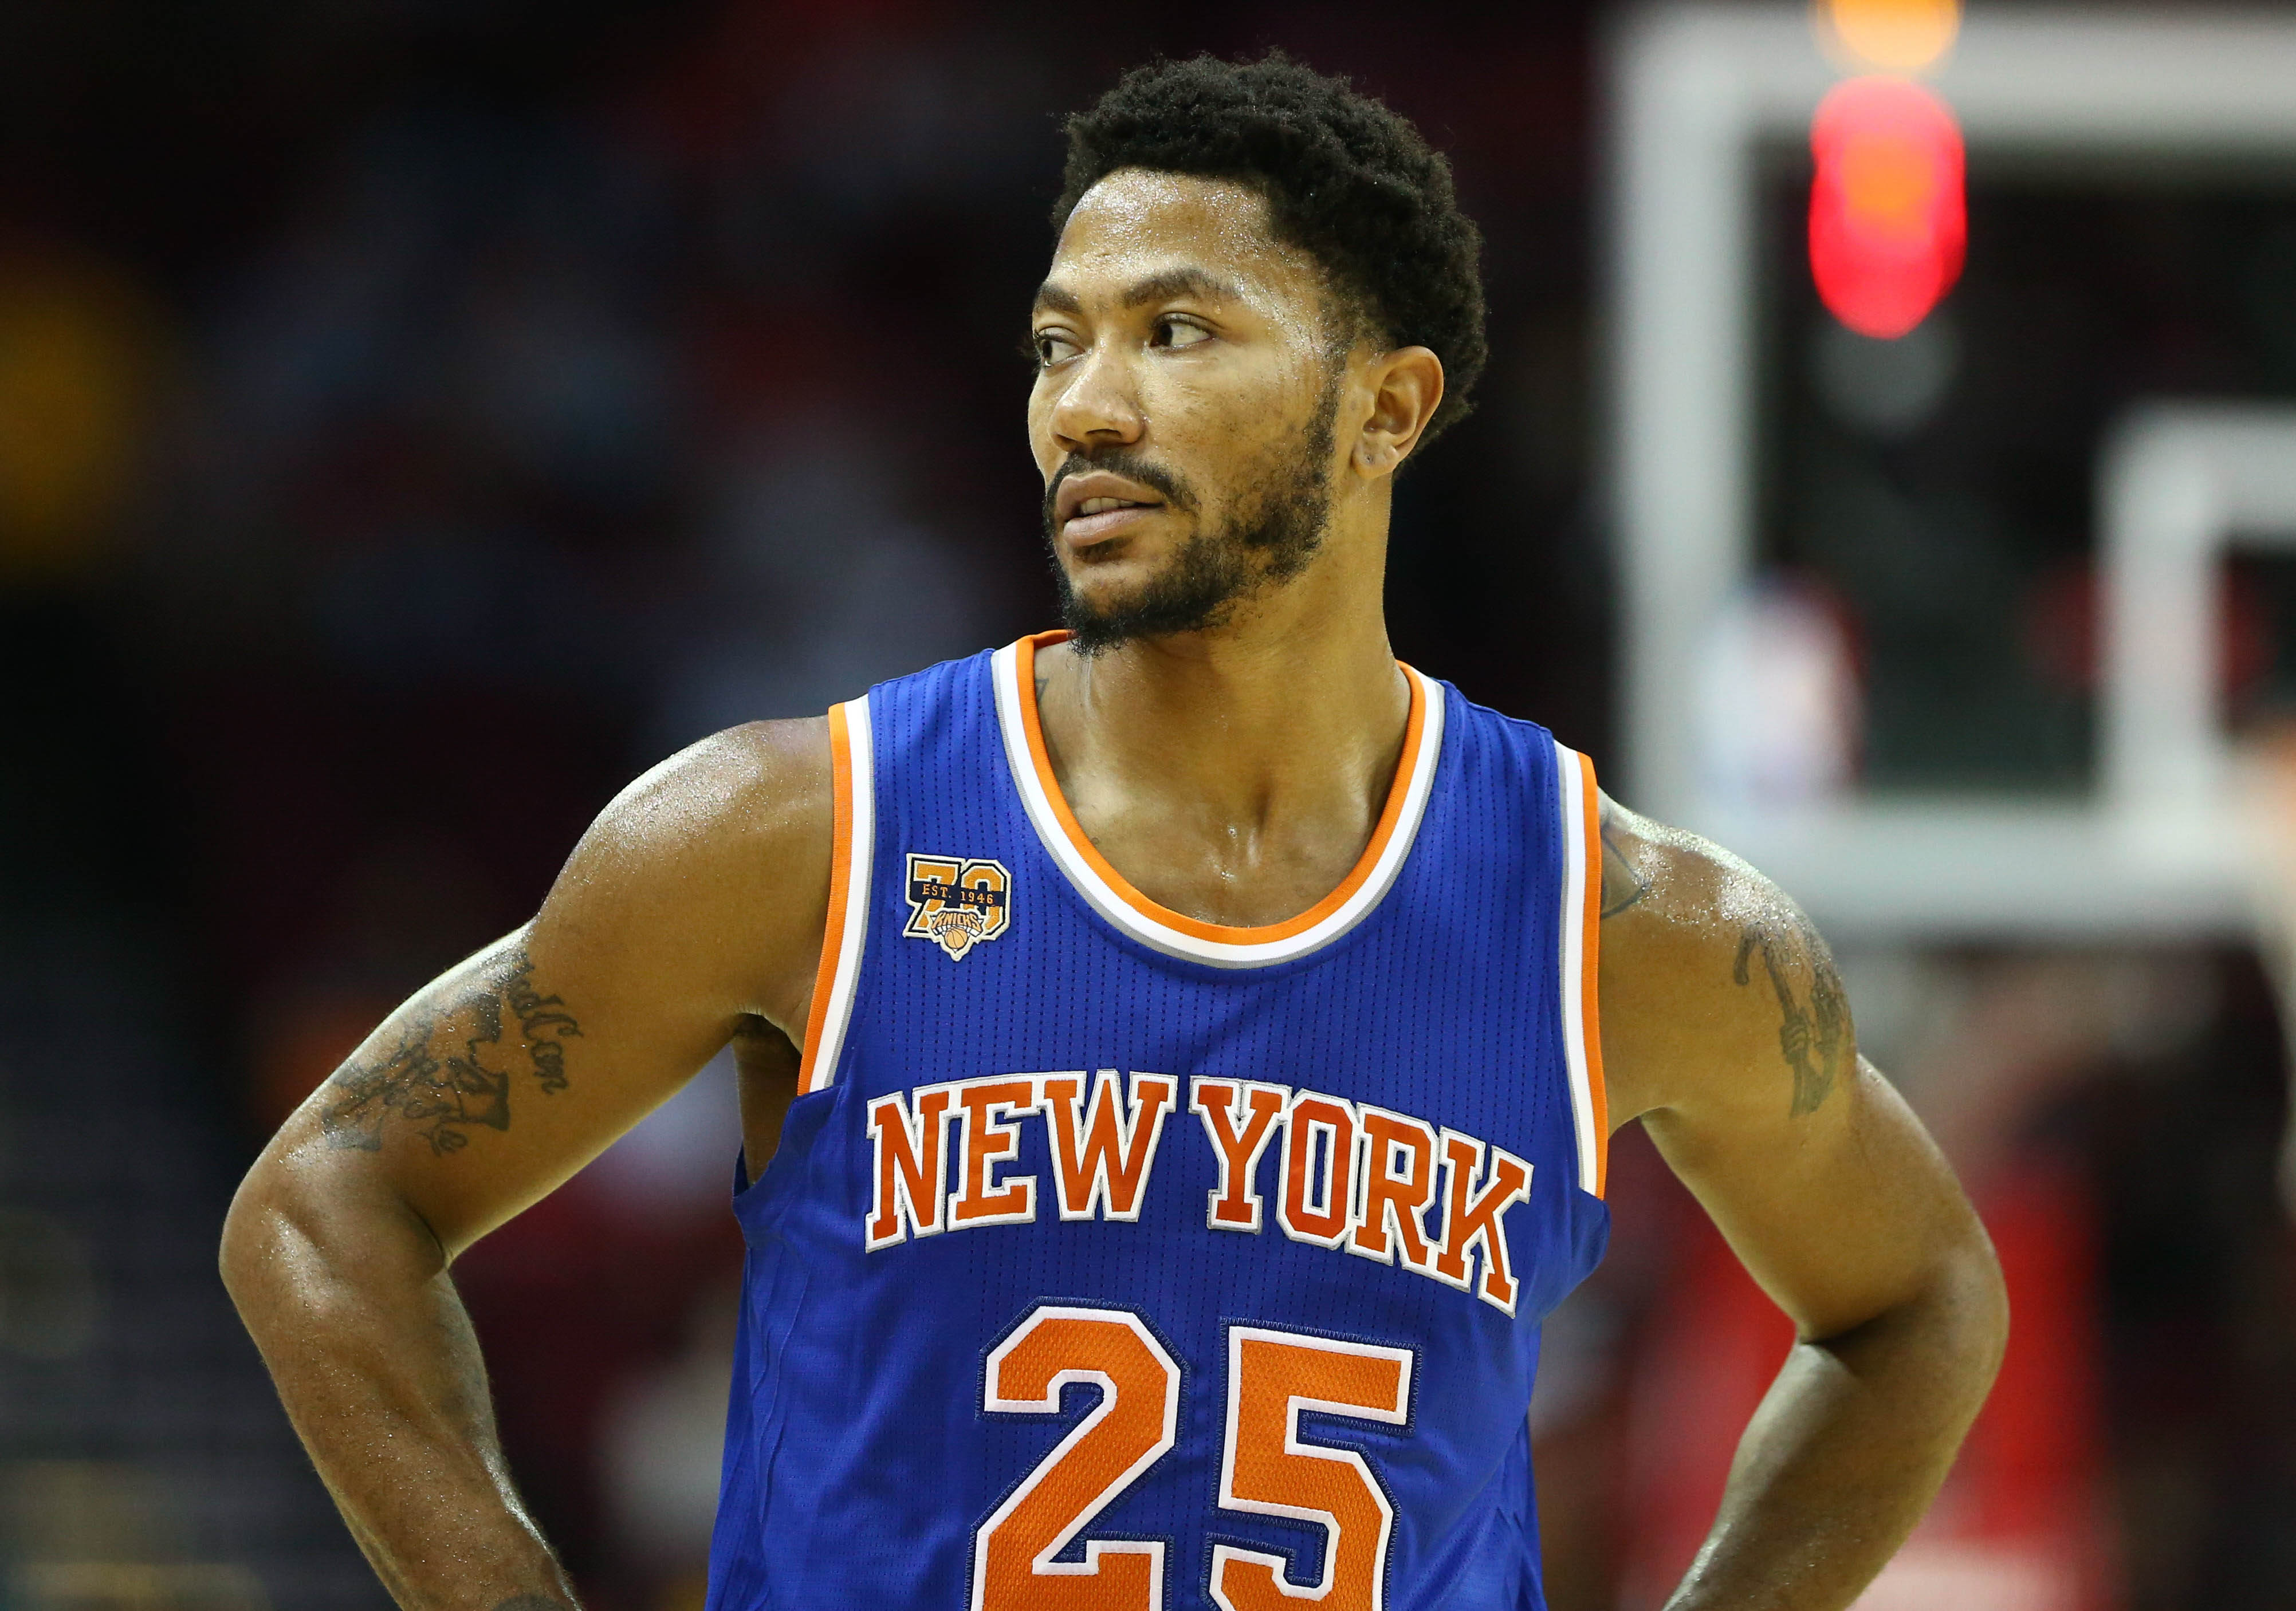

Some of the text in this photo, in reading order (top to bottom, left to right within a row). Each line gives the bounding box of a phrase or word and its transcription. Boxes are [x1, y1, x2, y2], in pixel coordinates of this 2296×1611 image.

[906, 855, 1009, 936] 70
[921, 883, 994, 904] EST. 1946
[931, 912, 983, 933] KNICKS
[865, 1069, 1534, 1317] NEW YORK
[970, 1305, 1413, 1611] 25
